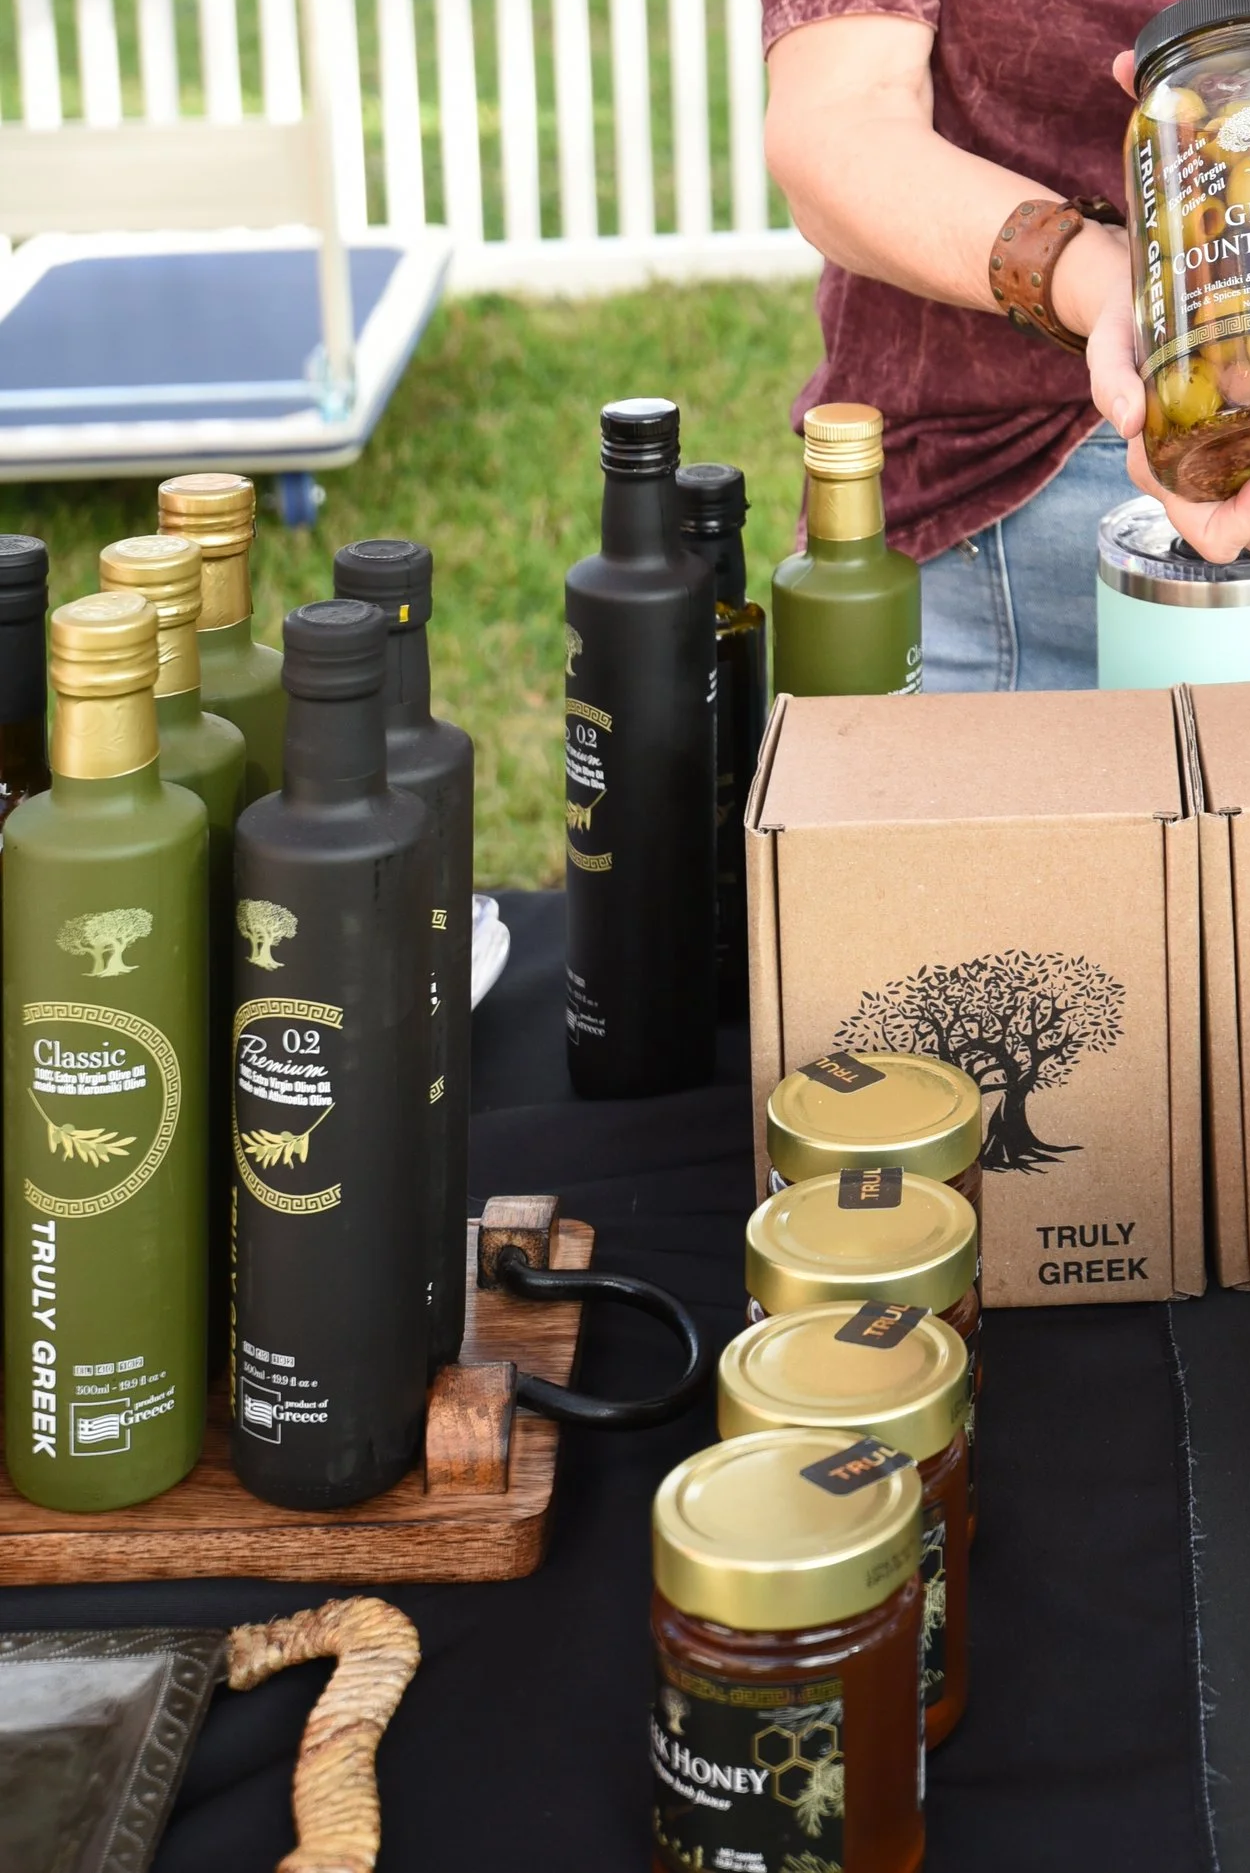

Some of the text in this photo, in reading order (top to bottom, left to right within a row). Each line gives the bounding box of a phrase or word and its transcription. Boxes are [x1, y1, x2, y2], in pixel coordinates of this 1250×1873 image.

[1162, 137, 1207, 180] Packed in
[1177, 155, 1204, 184] 100%
[1168, 161, 1227, 212] Extra Virgin
[1181, 178, 1226, 217] Olive Oil
[1140, 140, 1166, 342] TRULY GREEK
[1181, 287, 1202, 302] Greek
[1204, 275, 1243, 293] Halkidiki
[1181, 299, 1202, 314] Herbs
[1203, 296, 1211, 305] &
[1213, 289, 1241, 303] Spices
[33, 1038, 126, 1069] Classic
[282, 1029, 320, 1054] 0.2
[240, 1034, 329, 1078] Premium
[815, 1057, 859, 1083] TRUL
[33, 1081, 56, 1093] made
[56, 1084, 77, 1095] with
[123, 1078, 146, 1091] Olive
[54, 1070, 77, 1084] Extra
[77, 1072, 107, 1086] Virgin
[106, 1069, 131, 1081] Olive
[132, 1065, 146, 1077] Oil
[252, 1070, 331, 1094] Extra Virgin Olive Oil
[253, 1085, 332, 1106] with Olive
[861, 1168, 882, 1200] TRUL
[1036, 1222, 1136, 1249] TRULY
[1038, 1257, 1149, 1286] GREEK
[862, 1305, 911, 1337] TRUL
[31, 1220, 57, 1458] TRULY GREEK
[134, 1385, 176, 1411] product of
[285, 1399, 329, 1409] product of
[119, 1399, 175, 1426] Greece
[273, 1404, 328, 1423] Greece
[828, 1446, 899, 1480] TRUL
[670, 1741, 769, 1795] HONEY
